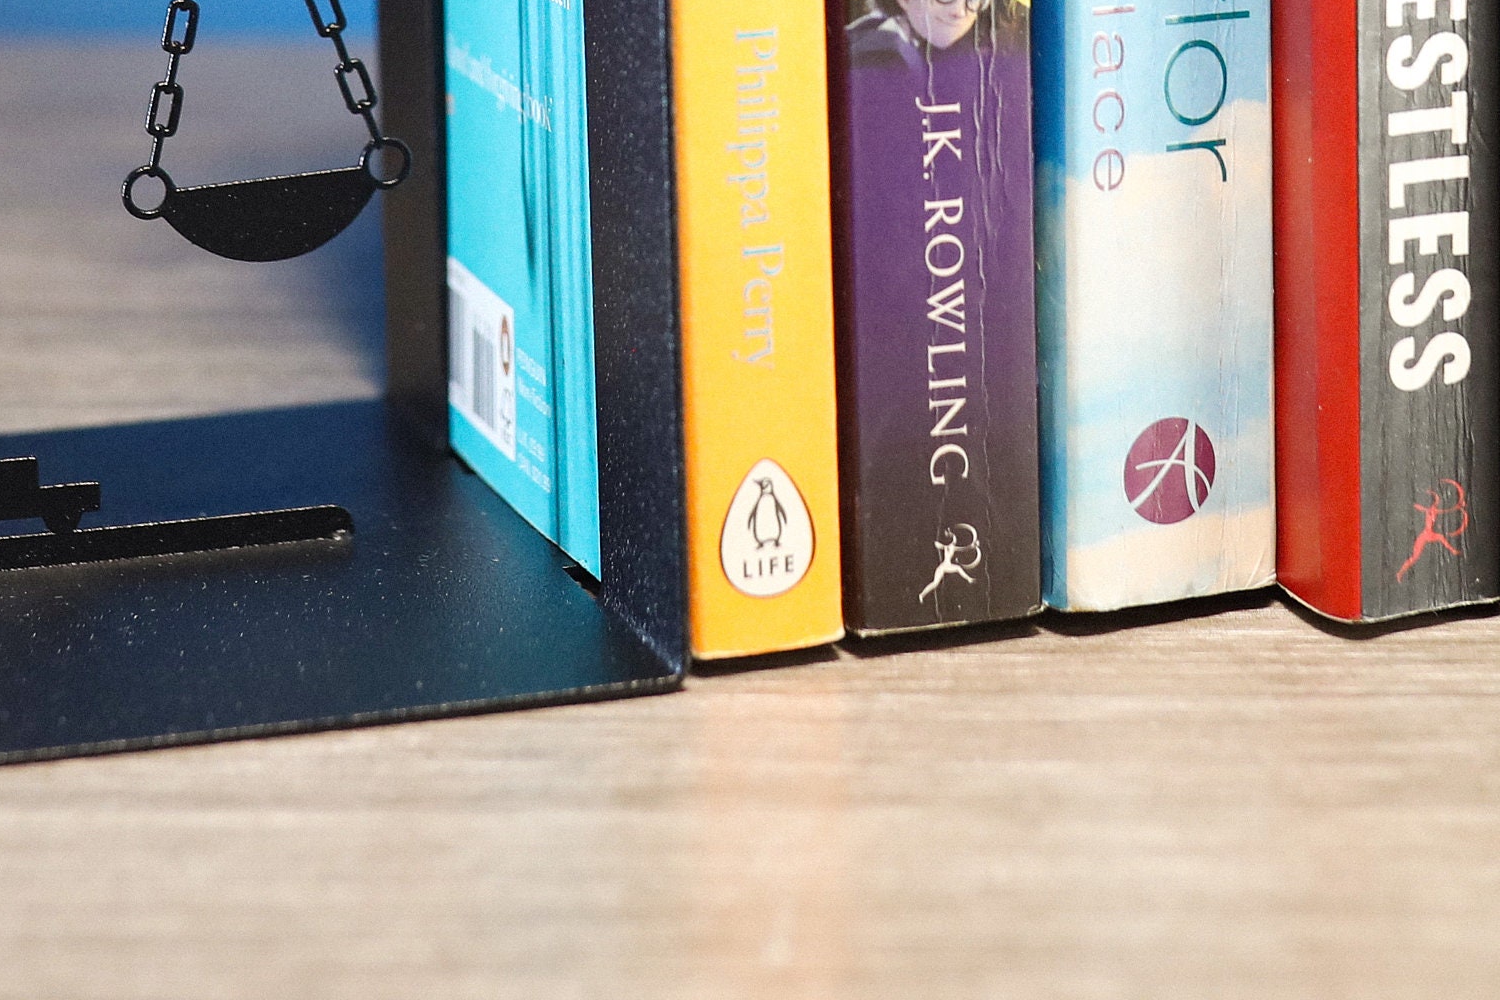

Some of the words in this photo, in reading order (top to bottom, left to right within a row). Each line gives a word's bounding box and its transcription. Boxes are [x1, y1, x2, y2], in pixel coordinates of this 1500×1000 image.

[725, 27, 779, 228] Philippa
[914, 96, 963, 181] J.K.
[731, 244, 785, 370] Perry
[923, 196, 970, 487] ROWLING
[743, 554, 796, 579] LIFE
